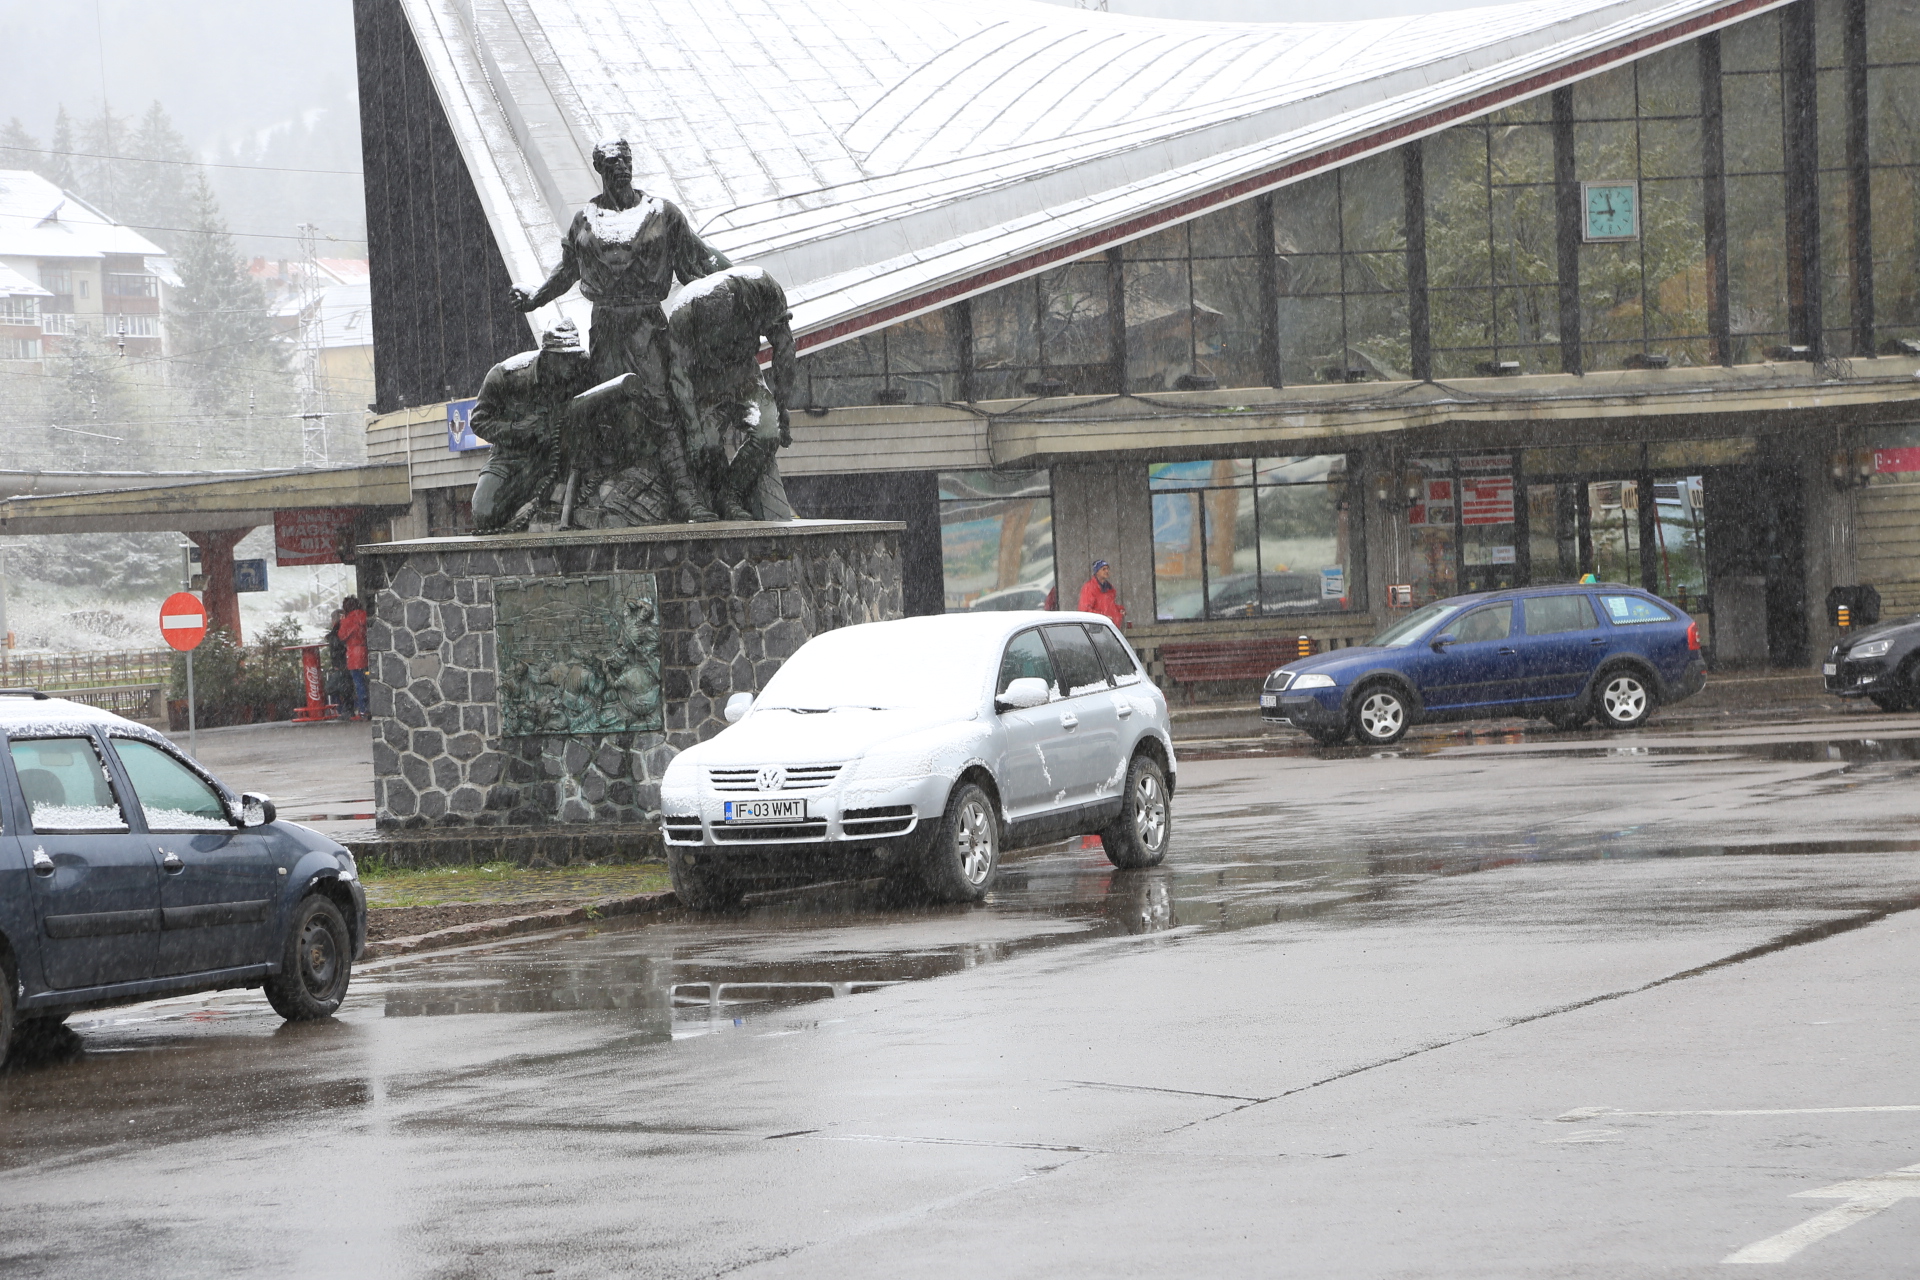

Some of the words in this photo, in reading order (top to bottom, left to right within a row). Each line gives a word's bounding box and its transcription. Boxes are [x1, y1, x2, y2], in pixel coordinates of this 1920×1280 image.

[301, 537, 332, 549] MIX
[735, 803, 748, 818] IF
[753, 803, 769, 817] 03
[771, 801, 800, 816] WMT
